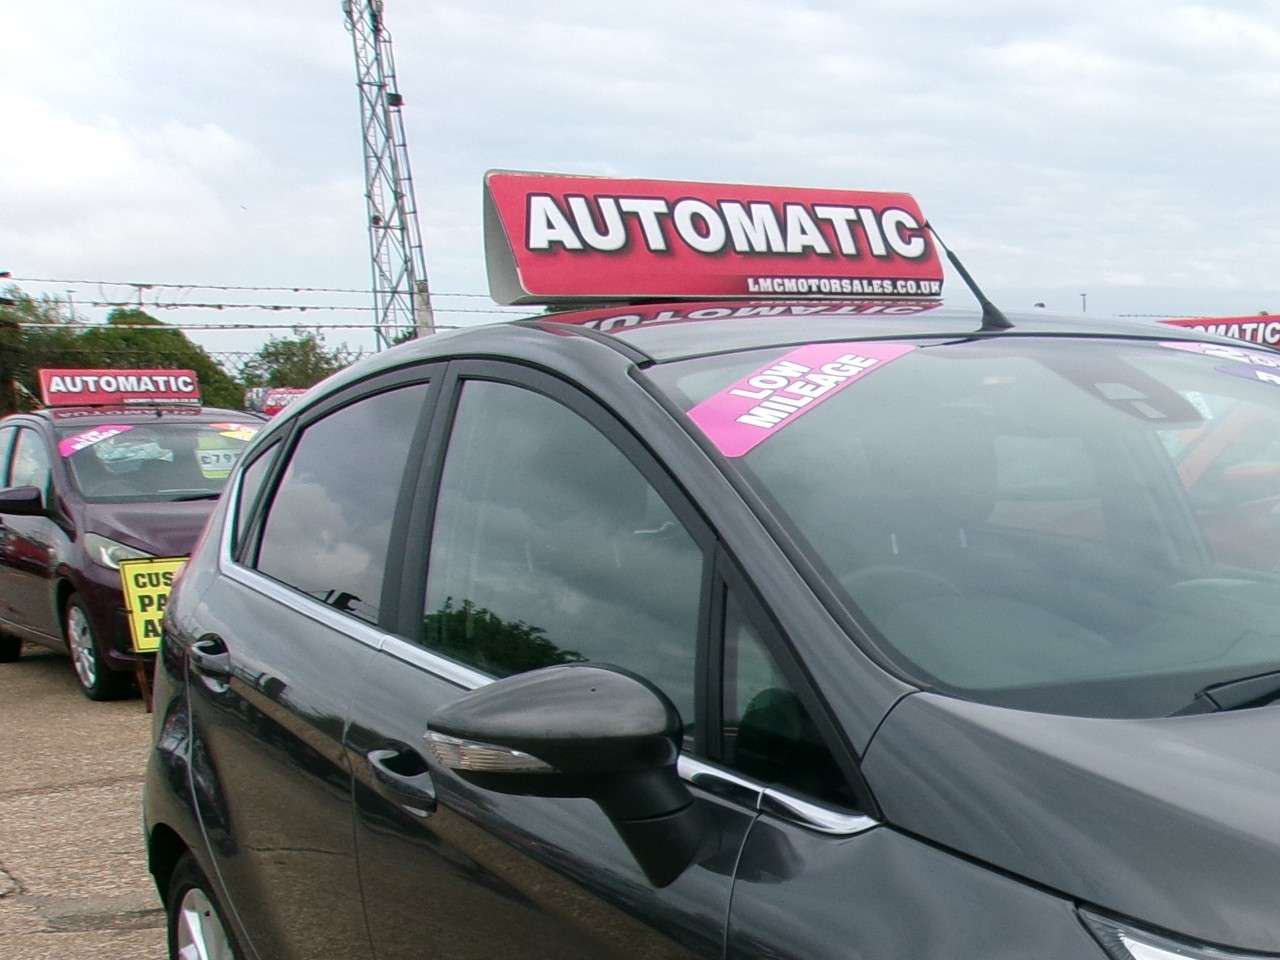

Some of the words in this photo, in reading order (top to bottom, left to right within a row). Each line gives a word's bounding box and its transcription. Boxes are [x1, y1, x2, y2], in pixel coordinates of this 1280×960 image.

[527, 193, 928, 260] AUTOMATIC
[747, 277, 942, 295] LMCMOTORSALES.CO.UK
[49, 375, 195, 393] AUTOMATIC
[729, 359, 811, 401] LOW
[737, 353, 880, 428] MILEAGE
